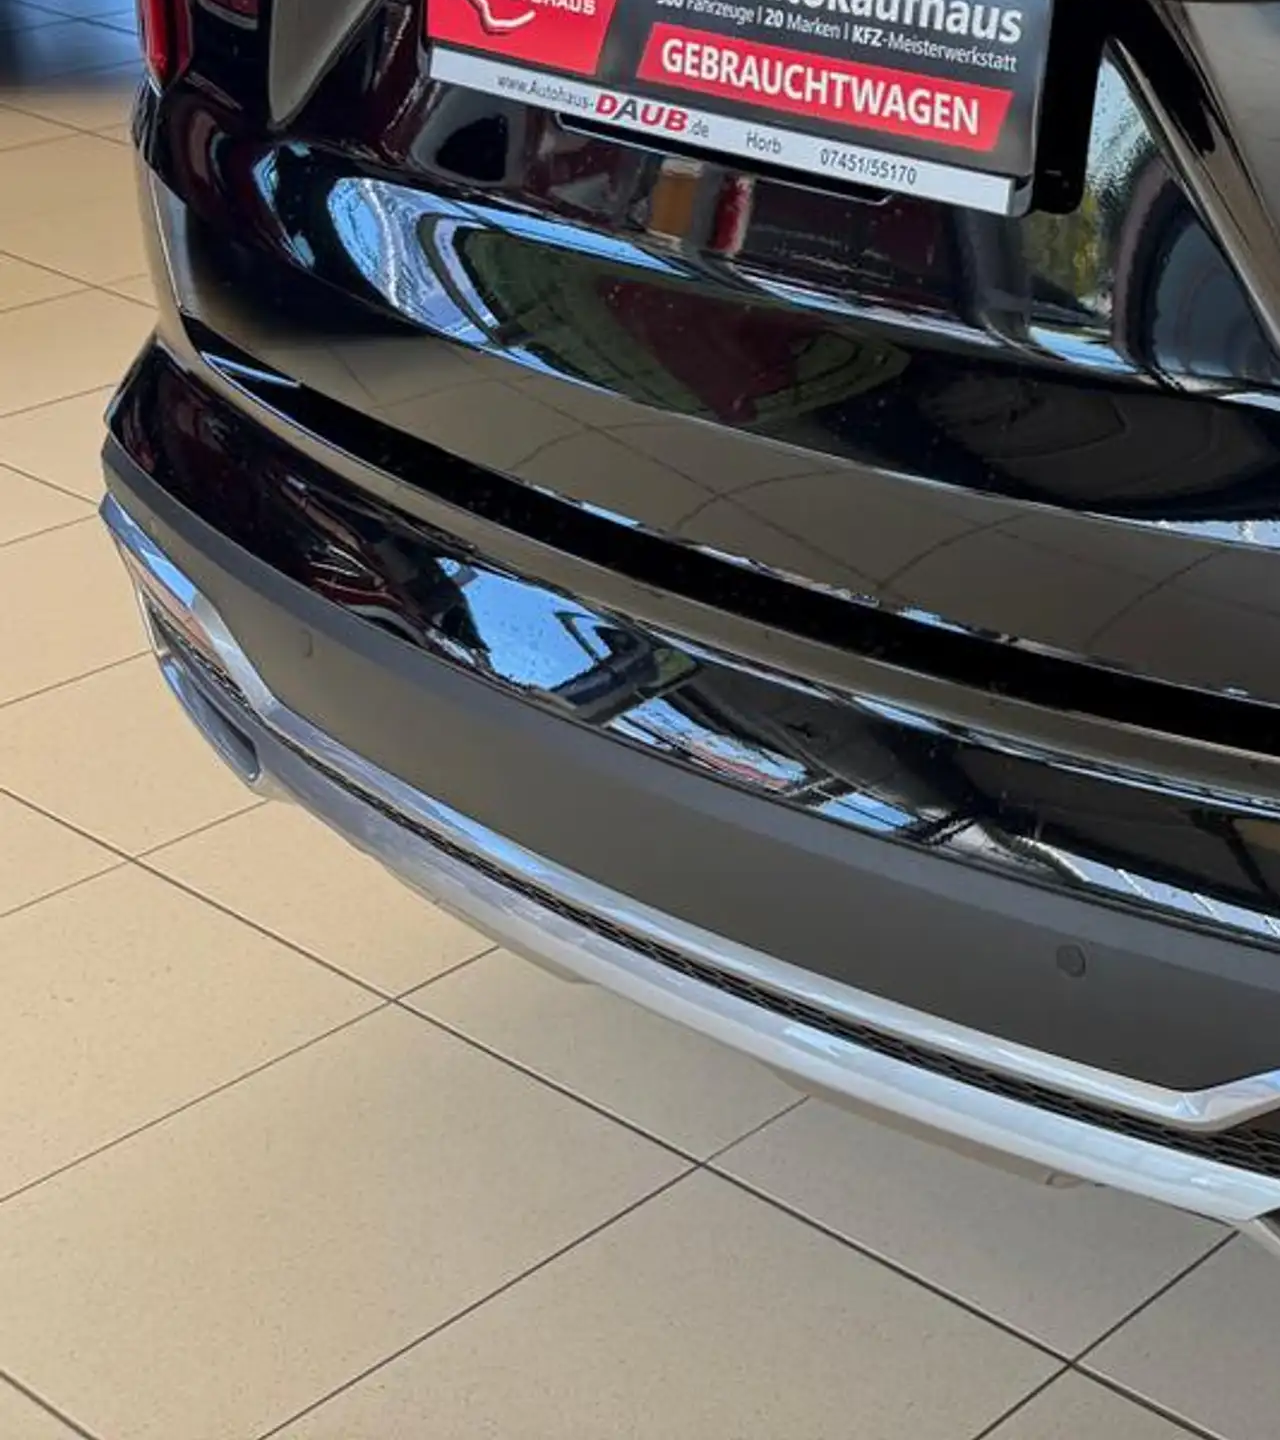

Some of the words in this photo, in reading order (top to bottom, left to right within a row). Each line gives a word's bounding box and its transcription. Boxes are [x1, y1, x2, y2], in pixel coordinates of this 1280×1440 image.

[764, 9, 784, 28] 20
[786, 13, 841, 40] Marken
[851, 23, 1018, 73] KFZ-Meisterwerkstatt
[661, 37, 980, 135] GEBRAUCHTWAGEN
[745, 129, 782, 155] Horb
[819, 146, 918, 187] 07451/55170
